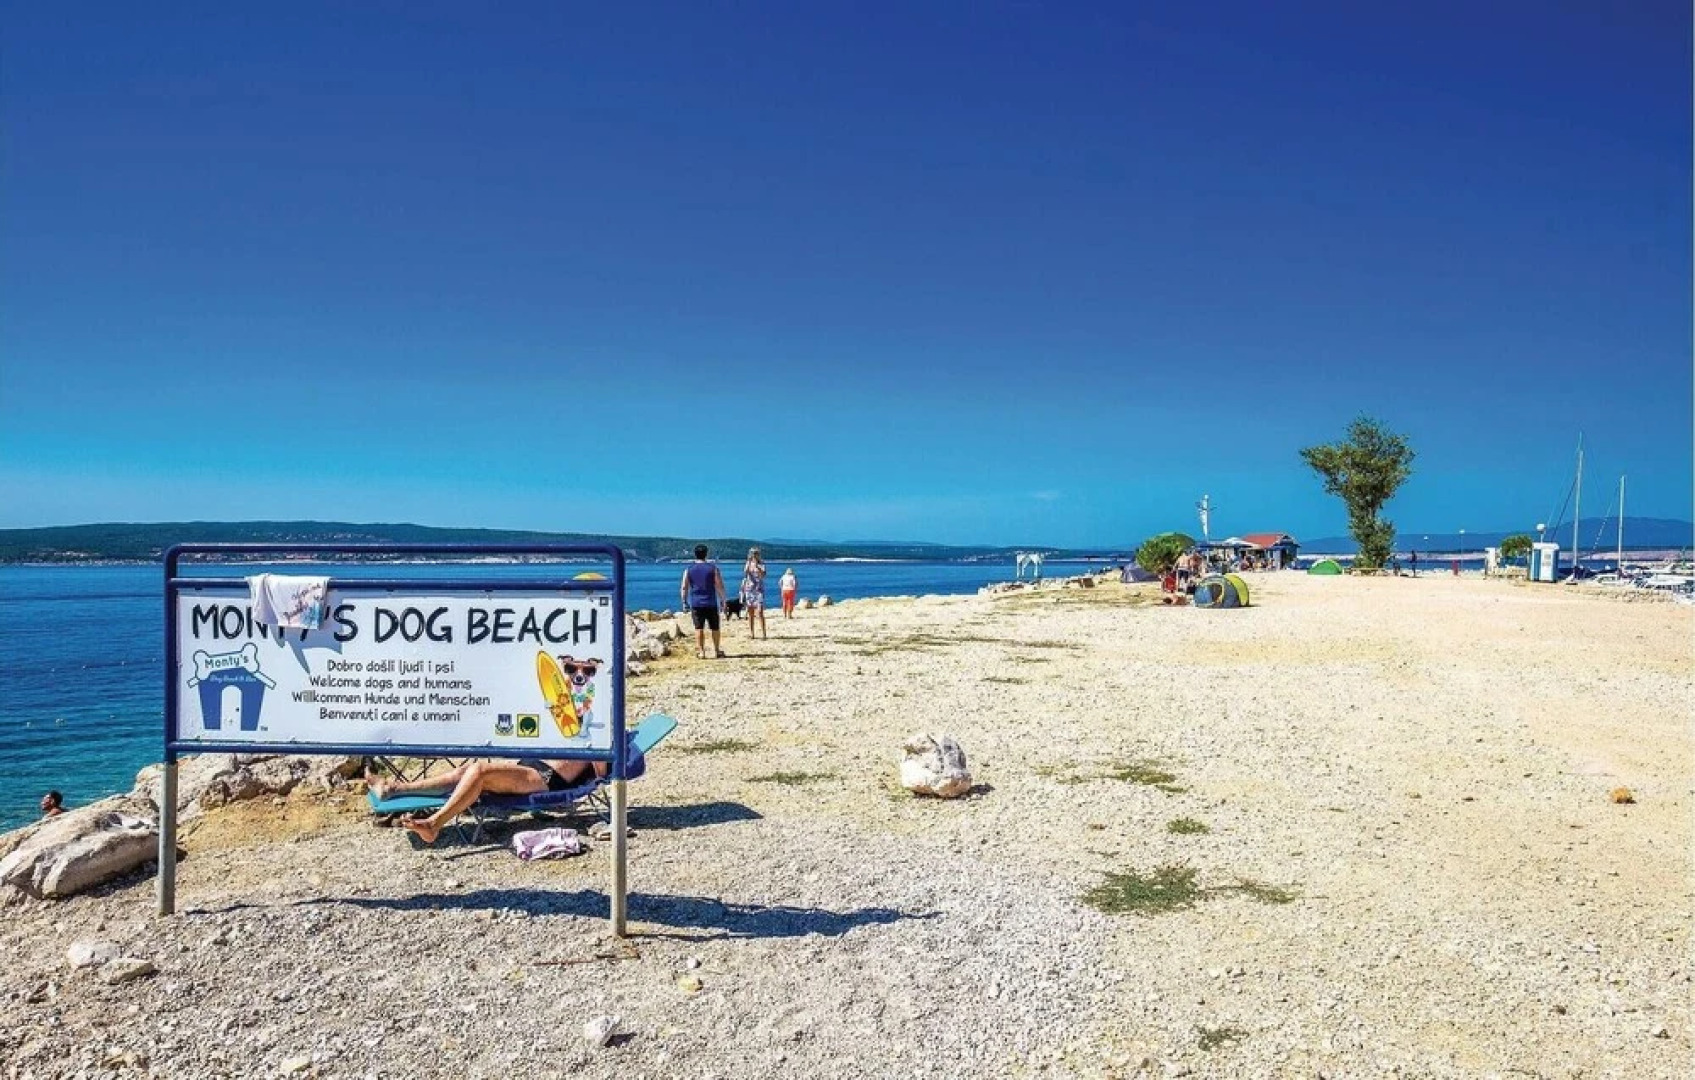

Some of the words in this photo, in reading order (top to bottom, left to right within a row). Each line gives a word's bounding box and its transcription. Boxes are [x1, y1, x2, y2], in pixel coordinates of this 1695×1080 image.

[193, 603, 359, 642] MON'S
[374, 606, 453, 643] DOG
[467, 606, 598, 646] BEACH
[204, 654, 249, 669] Monty's
[327, 659, 363, 672] Dobro
[366, 659, 396, 673] došli
[399, 659, 424, 676] ljudi
[428, 661, 432, 673] i
[435, 661, 455, 675] psi
[309, 674, 361, 688] Welcome
[364, 676, 394, 692] dogs
[398, 677, 421, 689] and
[425, 677, 472, 690] humans
[291, 690, 362, 702] Willkommen
[364, 692, 400, 704] Hunde
[404, 693, 426, 705] und
[429, 693, 490, 705] Menschen
[320, 707, 379, 720] Benvenuti
[381, 709, 408, 721] cani
[411, 711, 419, 721] e
[424, 710, 460, 722] umani
